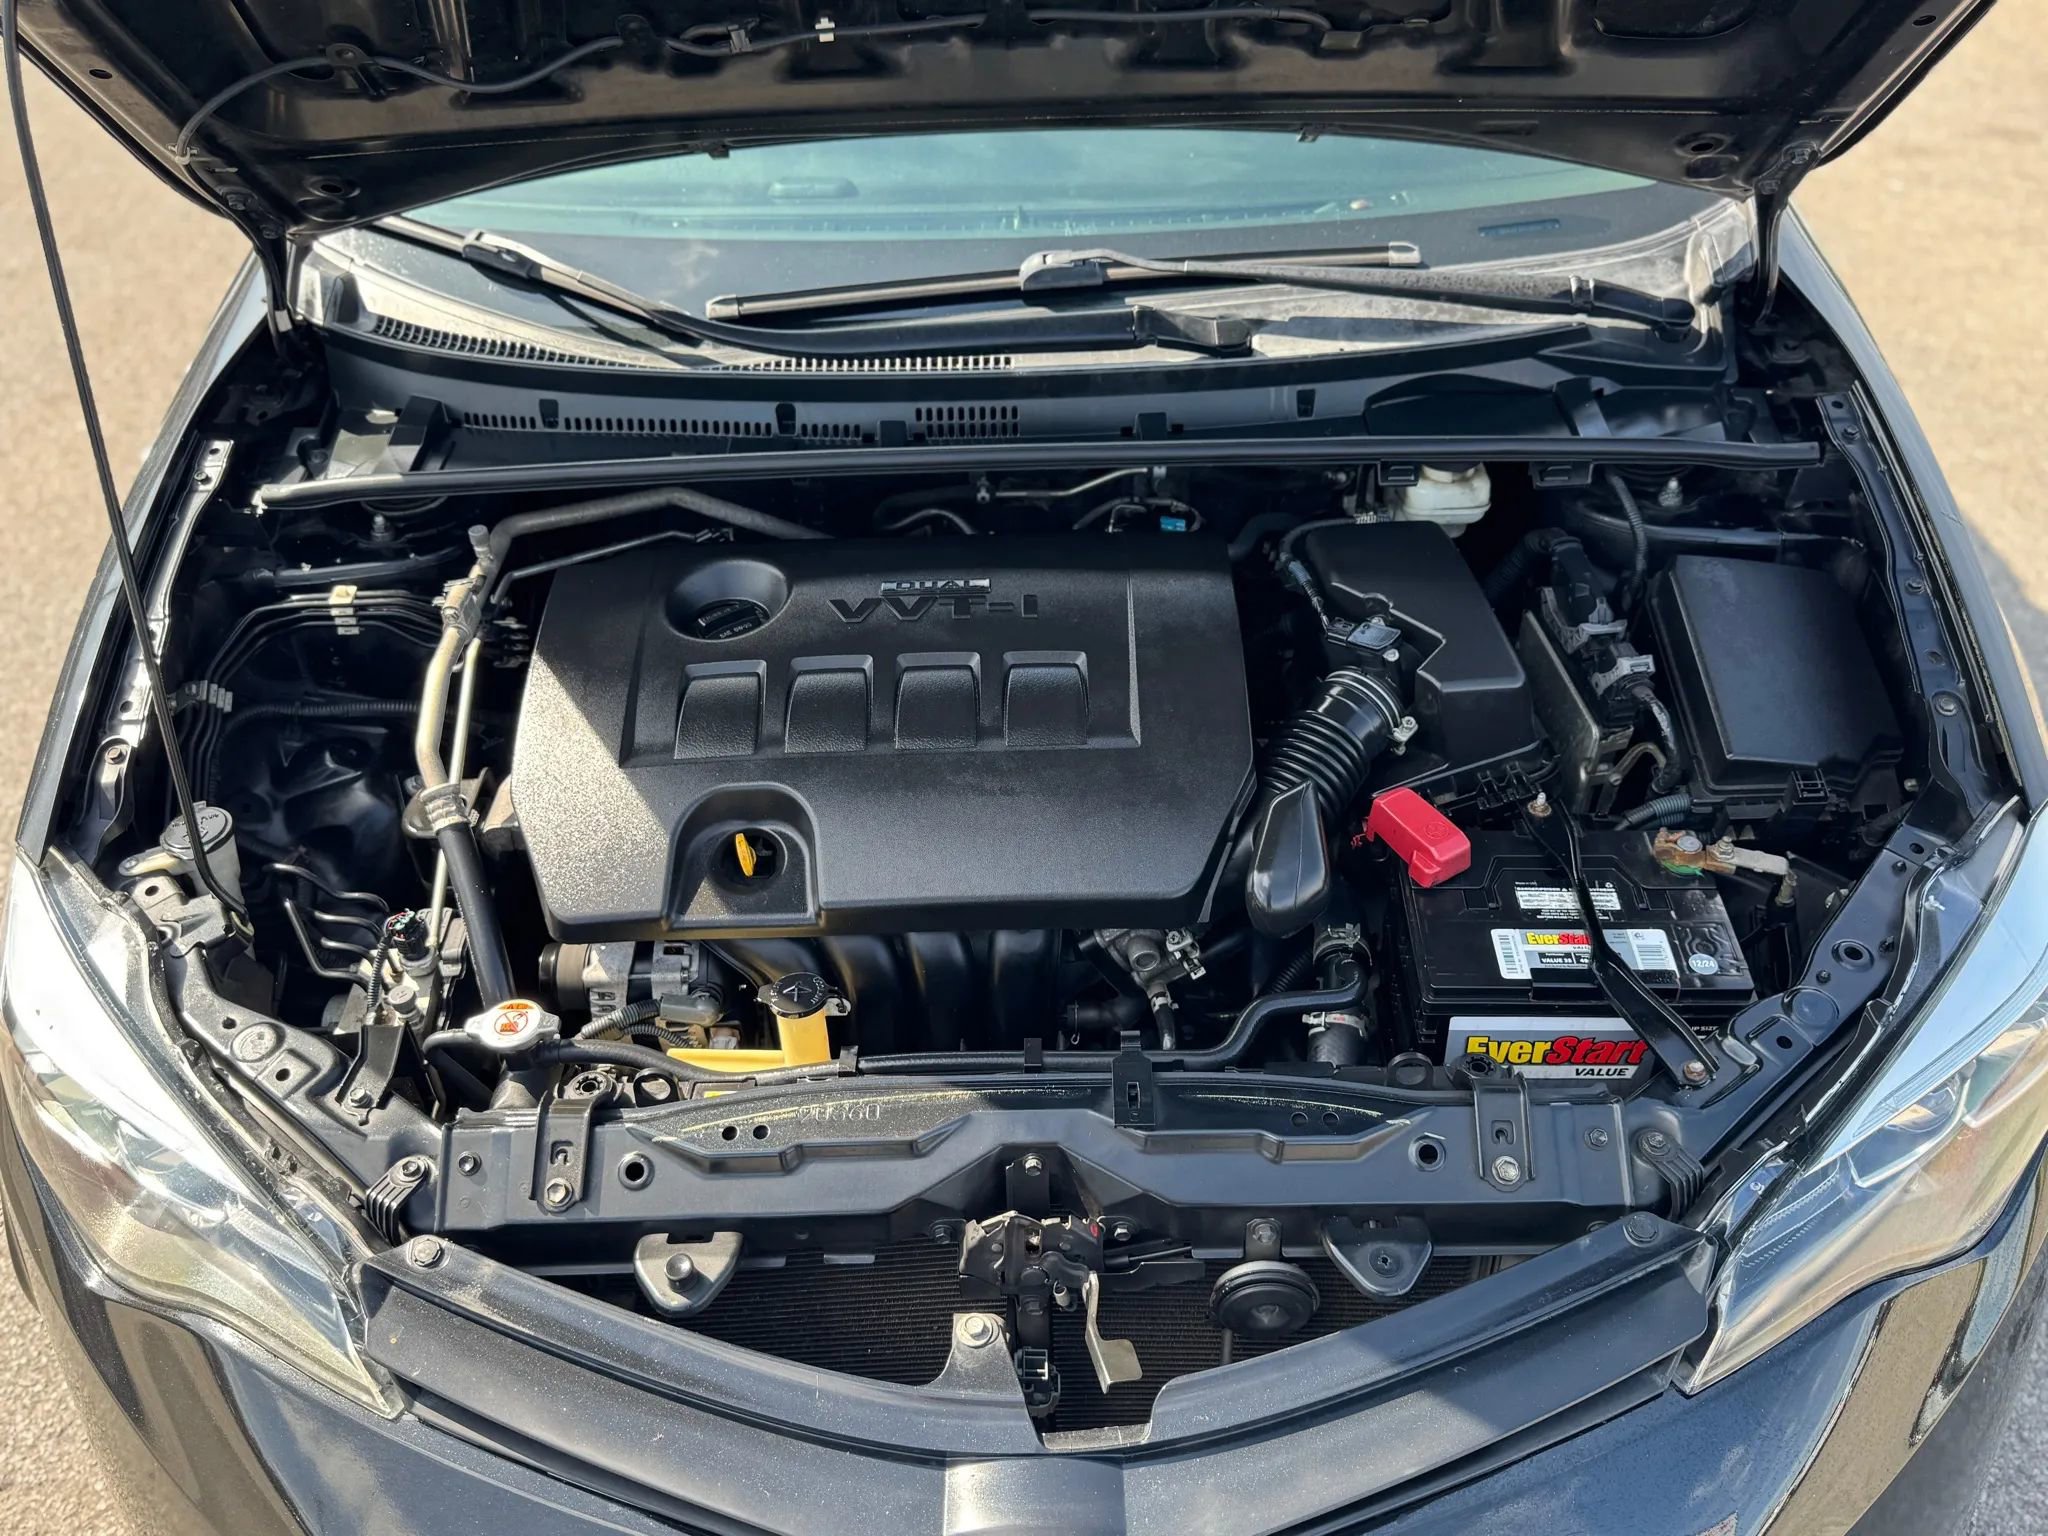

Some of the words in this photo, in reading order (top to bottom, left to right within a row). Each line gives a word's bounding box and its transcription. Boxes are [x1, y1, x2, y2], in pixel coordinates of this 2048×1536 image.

[892, 579, 978, 593] DUAL
[1691, 959, 1715, 968] 12/24
[1466, 1035, 1649, 1065] EverStart
[1575, 1067, 1630, 1077] VALUE
